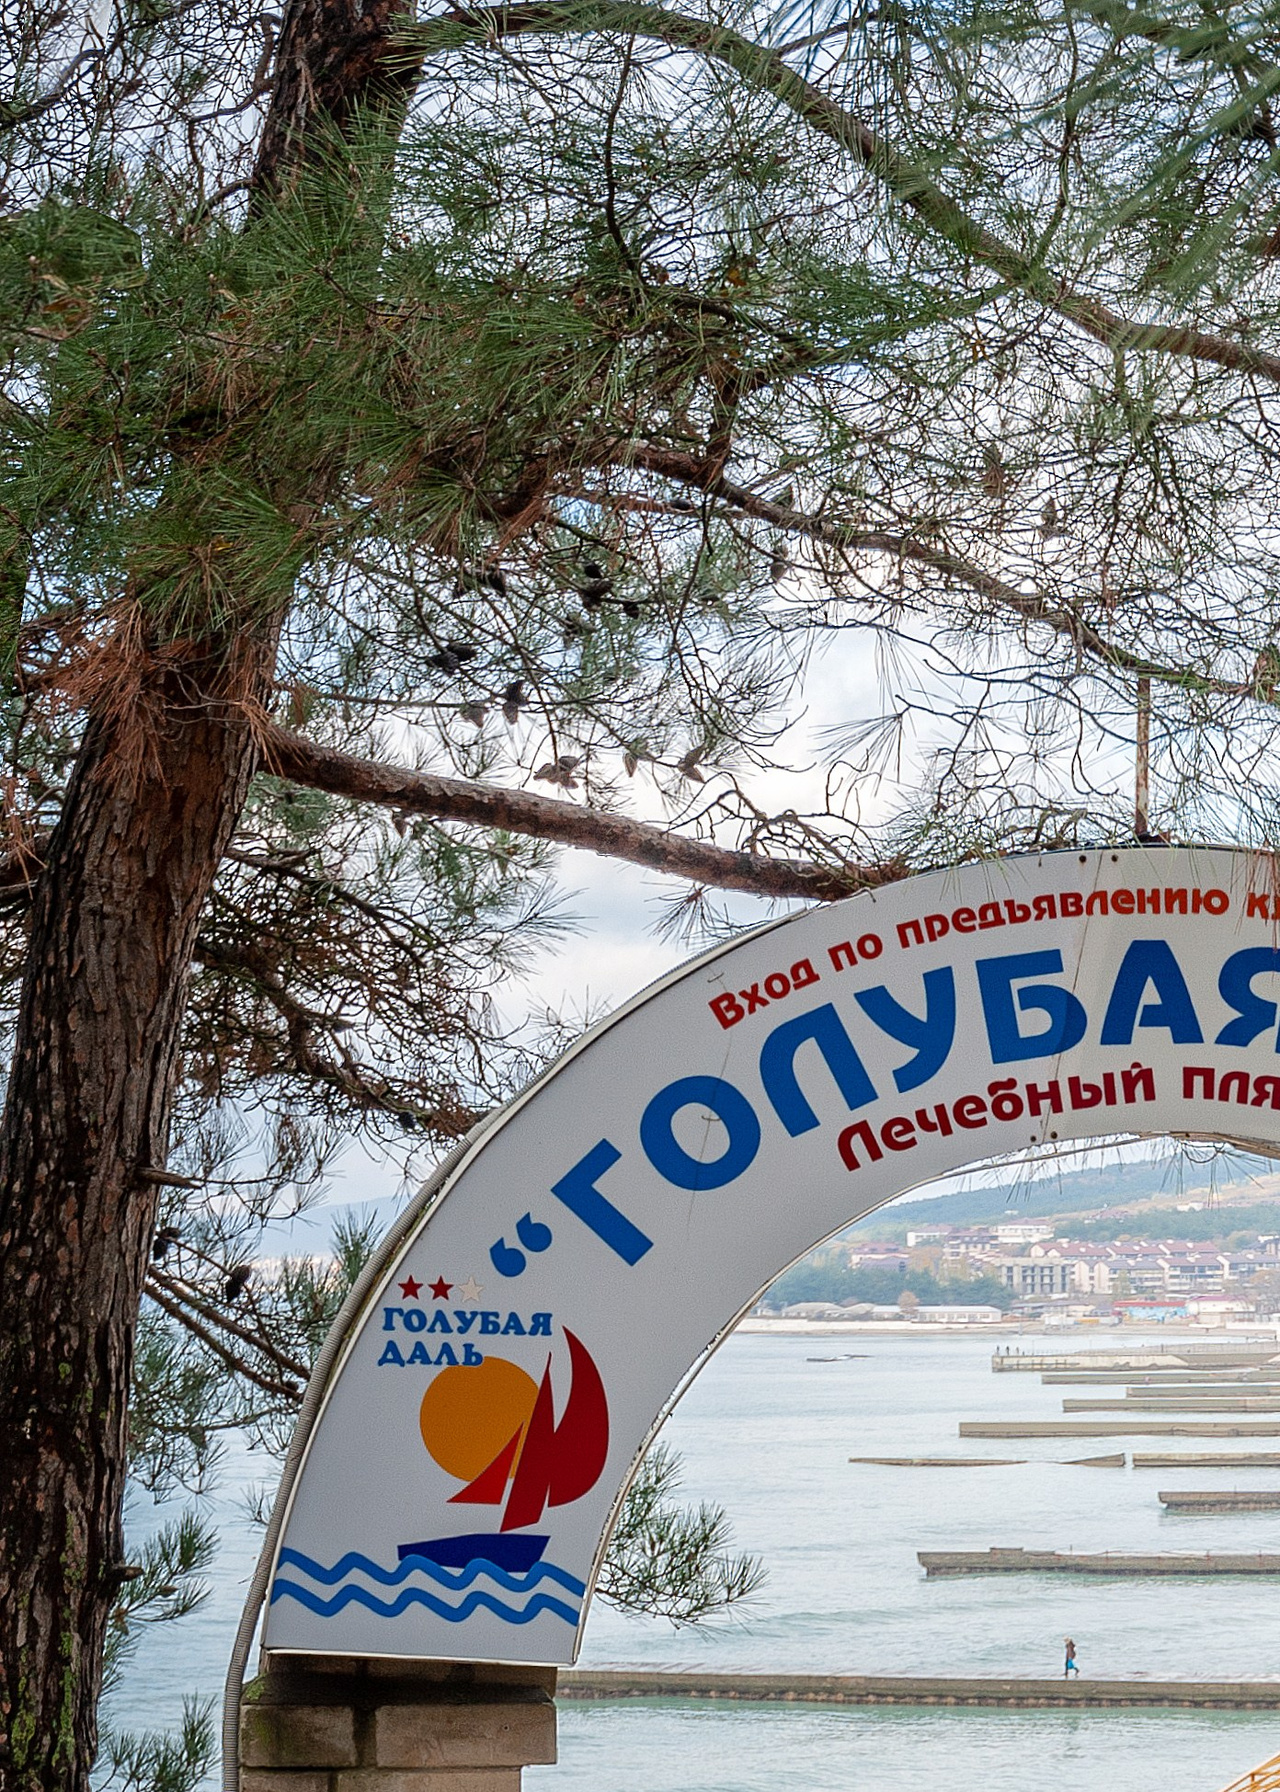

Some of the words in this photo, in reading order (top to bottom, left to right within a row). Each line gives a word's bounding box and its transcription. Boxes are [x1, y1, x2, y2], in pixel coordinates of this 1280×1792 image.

[708, 959, 820, 1029] Вход
[828, 933, 883, 971] по
[896, 888, 1230, 949] предъявлению
[837, 1062, 1156, 1171] Лечебный
[377, 1340, 483, 1368] ДАЛЬ
[382, 1307, 553, 1337] ГОЛУБАЯ
